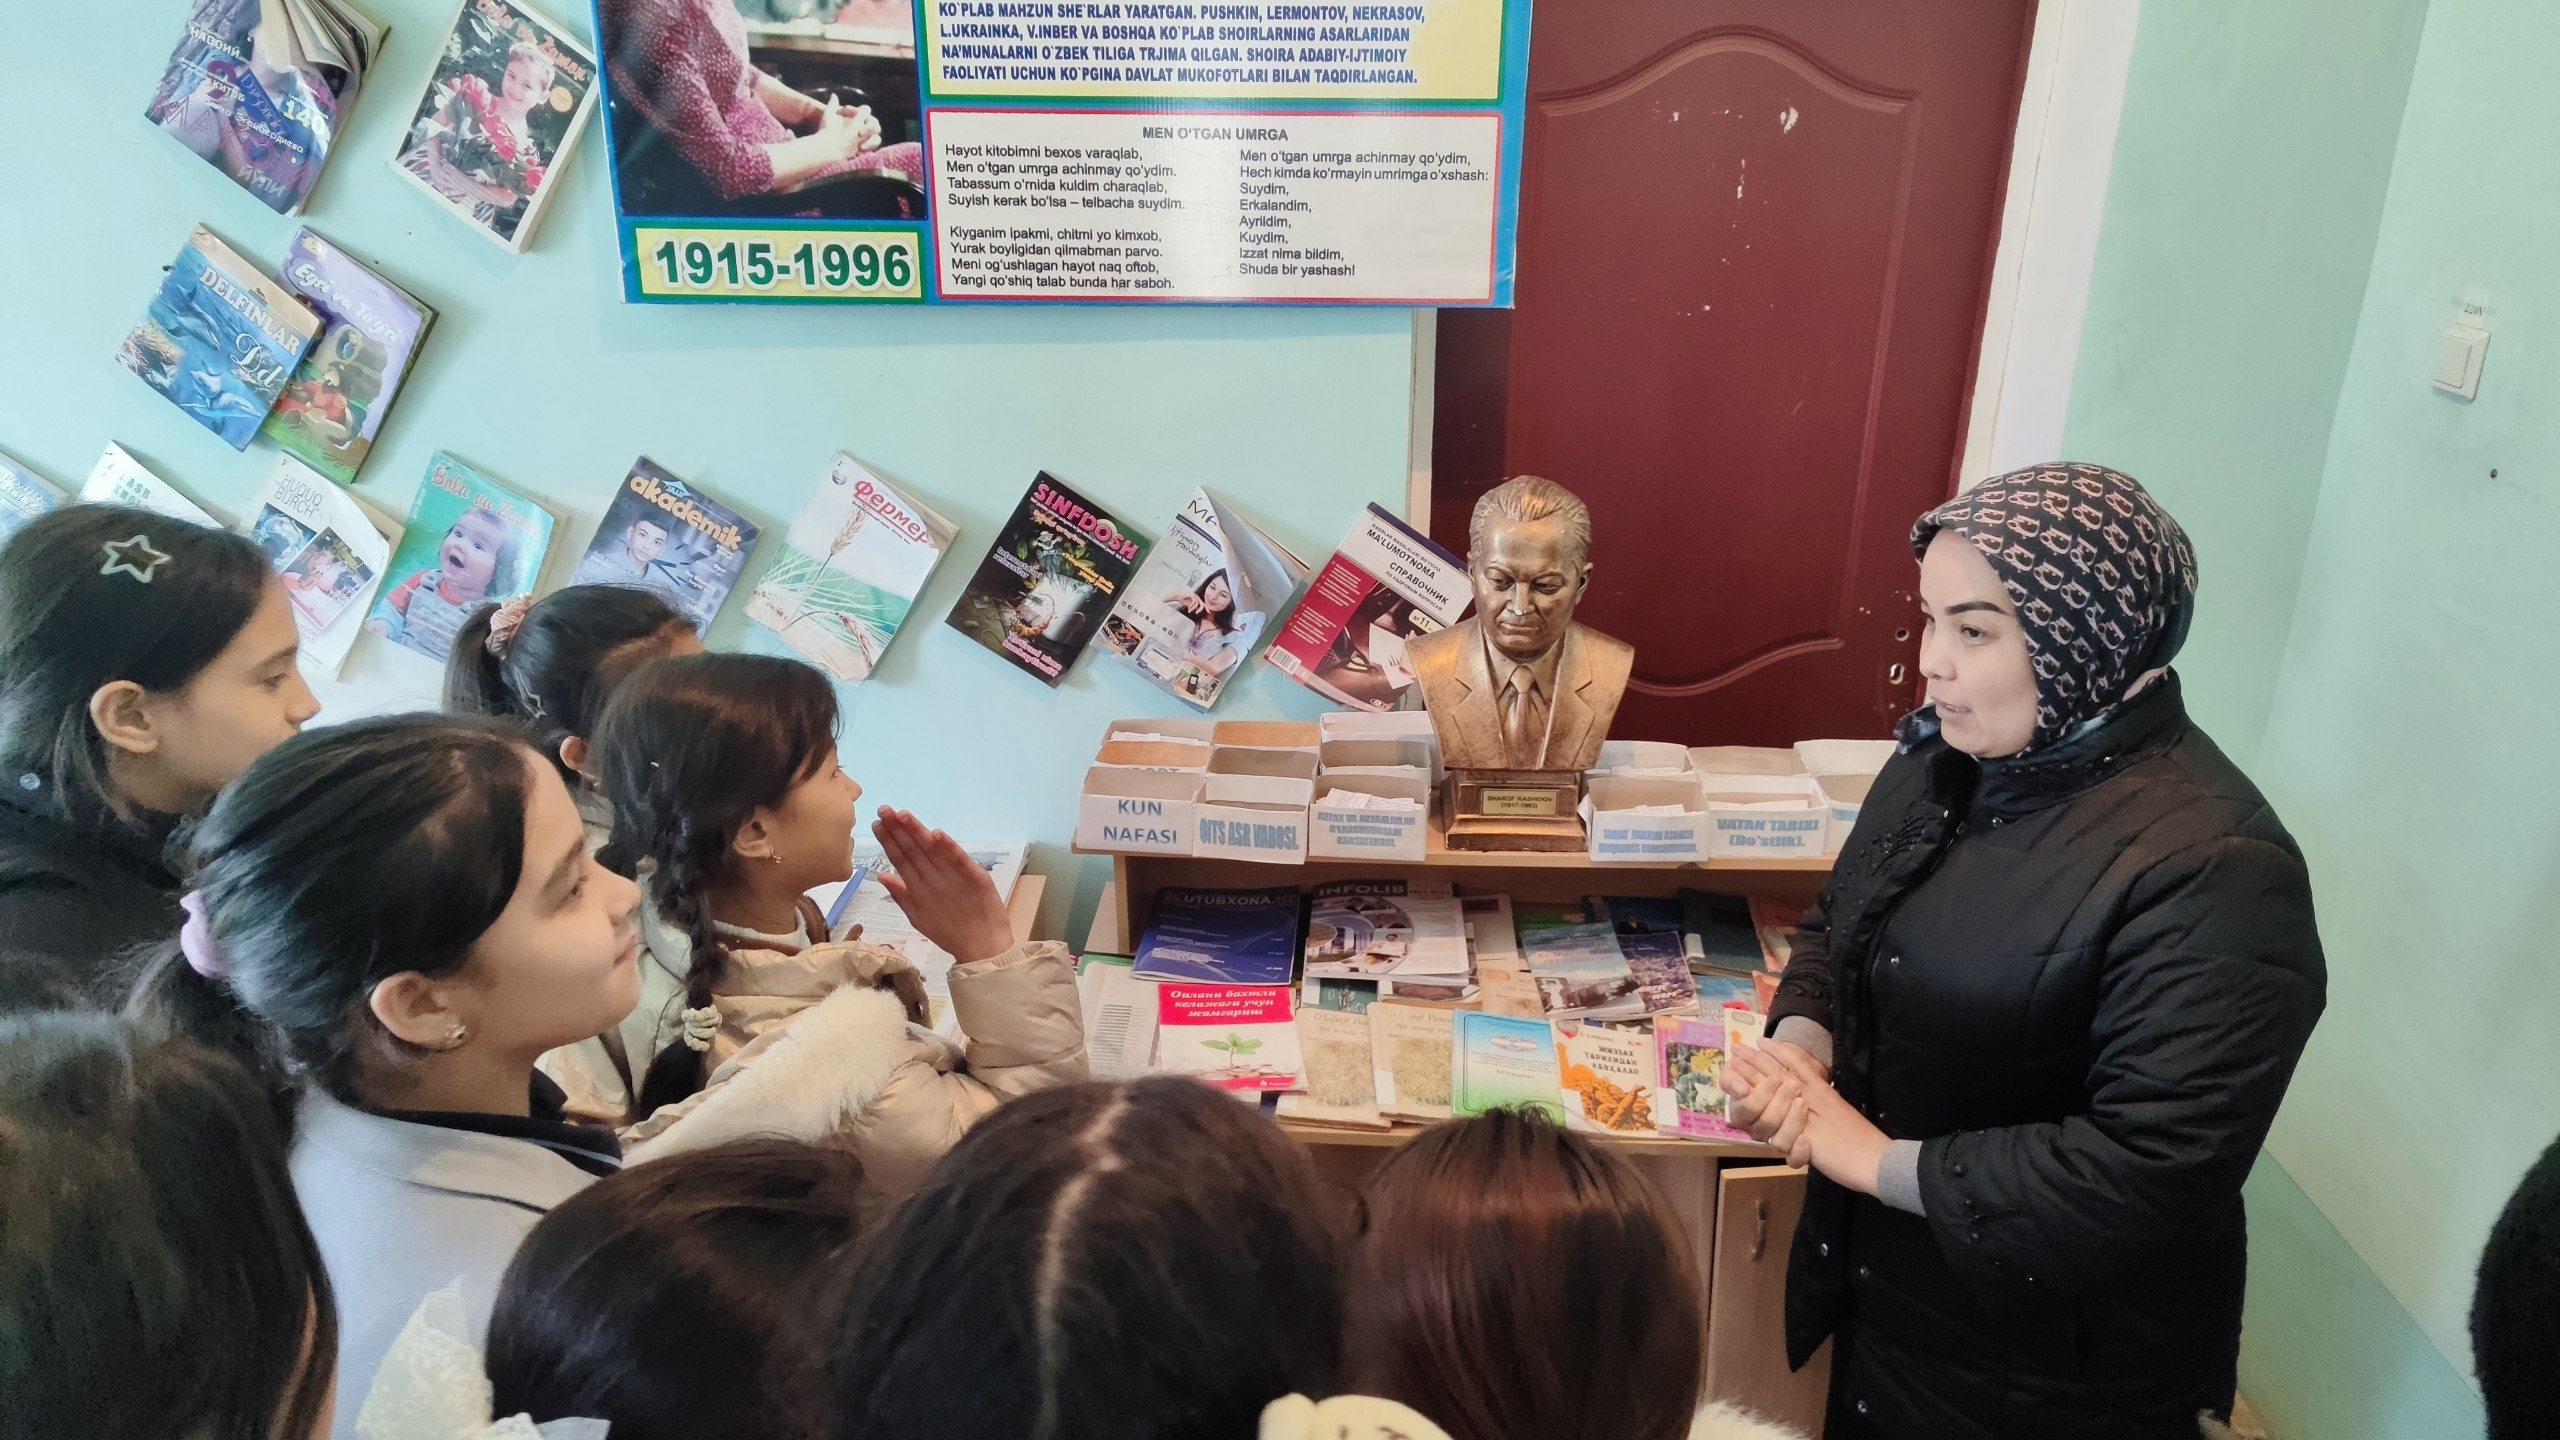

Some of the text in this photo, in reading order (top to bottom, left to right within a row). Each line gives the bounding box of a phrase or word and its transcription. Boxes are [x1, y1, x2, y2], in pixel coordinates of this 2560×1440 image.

[1000, 3, 1053, 17] MAHZUN
[1125, 5, 1196, 19] YARATGAN.
[1201, 5, 1262, 22] PUSHKIN,
[1267, 6, 1348, 23] LERMONTOV,
[1352, 6, 1425, 23] NEKRASOV,
[940, 24, 1023, 41] L.UKRAINKA,
[1027, 24, 1078, 39] V.INBER
[1080, 26, 1099, 39] VA
[1102, 26, 1156, 41] BOSHQA
[1218, 27, 1316, 41] SHOIRLARNING
[1319, 27, 1410, 42] ASARLARIDAN
[1093, 47, 1135, 61] TILIGA
[1139, 47, 1187, 61] TRJIMA
[1190, 48, 1242, 62] QILGAN.
[1247, 48, 1295, 62] SHOIRA
[1299, 48, 1407, 62] ADABIY-IJTIMOIY
[942, 65, 1007, 80] FAOLIYATI
[1011, 66, 1057, 81] UCHUN
[1126, 68, 1174, 82] DAVLAT
[1178, 68, 1268, 83] MUKOFOTLARI
[1273, 69, 1310, 83] BILAN
[1314, 69, 1418, 84] TAQDIRLANGAN.
[1142, 127, 1288, 141] MEN O'TGAN UMRGA
[946, 144, 1143, 161] Hayot kitobimni bexos varaqlab,
[1240, 150, 1471, 168] Men o'tgan umrga achinmay qo'ydim,
[946, 161, 1177, 178] Men o'tgan umrga achinmay qo'ydim.
[1240, 166, 1273, 178] Hech
[1273, 166, 1311, 179] kimda
[1313, 167, 1372, 182] ko'rmayin
[1374, 168, 1428, 183] umrimga
[947, 177, 1010, 190] Tabassum
[1059, 179, 1100, 192] kuldim
[1103, 180, 1168, 194] charaqlab,
[1239, 182, 1290, 198] Suydim,
[948, 194, 989, 208] Suyish
[993, 195, 1028, 207] kerak
[1082, 196, 1134, 209] telbacha
[1138, 197, 1185, 211] suydim.
[1239, 199, 1312, 214] Erkalandim,
[1239, 215, 1292, 230] Ayrildim,
[950, 226, 1162, 243] Kiyganim ipakmi, chitmi yo kimxob,
[1239, 231, 1288, 246] Kuydim,
[950, 243, 1163, 259] Yurak boyligidan qilmabman parvo.
[1239, 247, 1344, 262] Izzat nima bildim,
[656, 240, 911, 287] 1915-1996
[952, 258, 981, 270] Meni
[1062, 261, 1096, 274] hayot
[1099, 263, 1121, 274] naq
[1125, 261, 1159, 274] oftob,
[1239, 263, 1355, 279] Shuda bir yashash!
[952, 274, 986, 287] Yangi
[1036, 275, 1066, 287] talab
[1069, 276, 1107, 288] bunda
[1111, 277, 1130, 288] har
[1134, 277, 1175, 289] saboh.
[199, 265, 300, 356] DELFINLAR
[630, 475, 742, 550] akademik
[1033, 483, 1140, 560] SINFDOSH
[1389, 562, 1449, 605] СПРАВОЧНИК
[1420, 616, 1430, 627] 11
[1118, 799, 1162, 816] KUN
[1228, 821, 1251, 846] ASR
[1717, 819, 1819, 831] VATAN TARIXI
[1103, 826, 1177, 844] NAFASI
[1319, 885, 1405, 896] INFOLIB
[1170, 989, 1277, 998] Оилани бахтли
[1243, 999, 1274, 1008] учун
